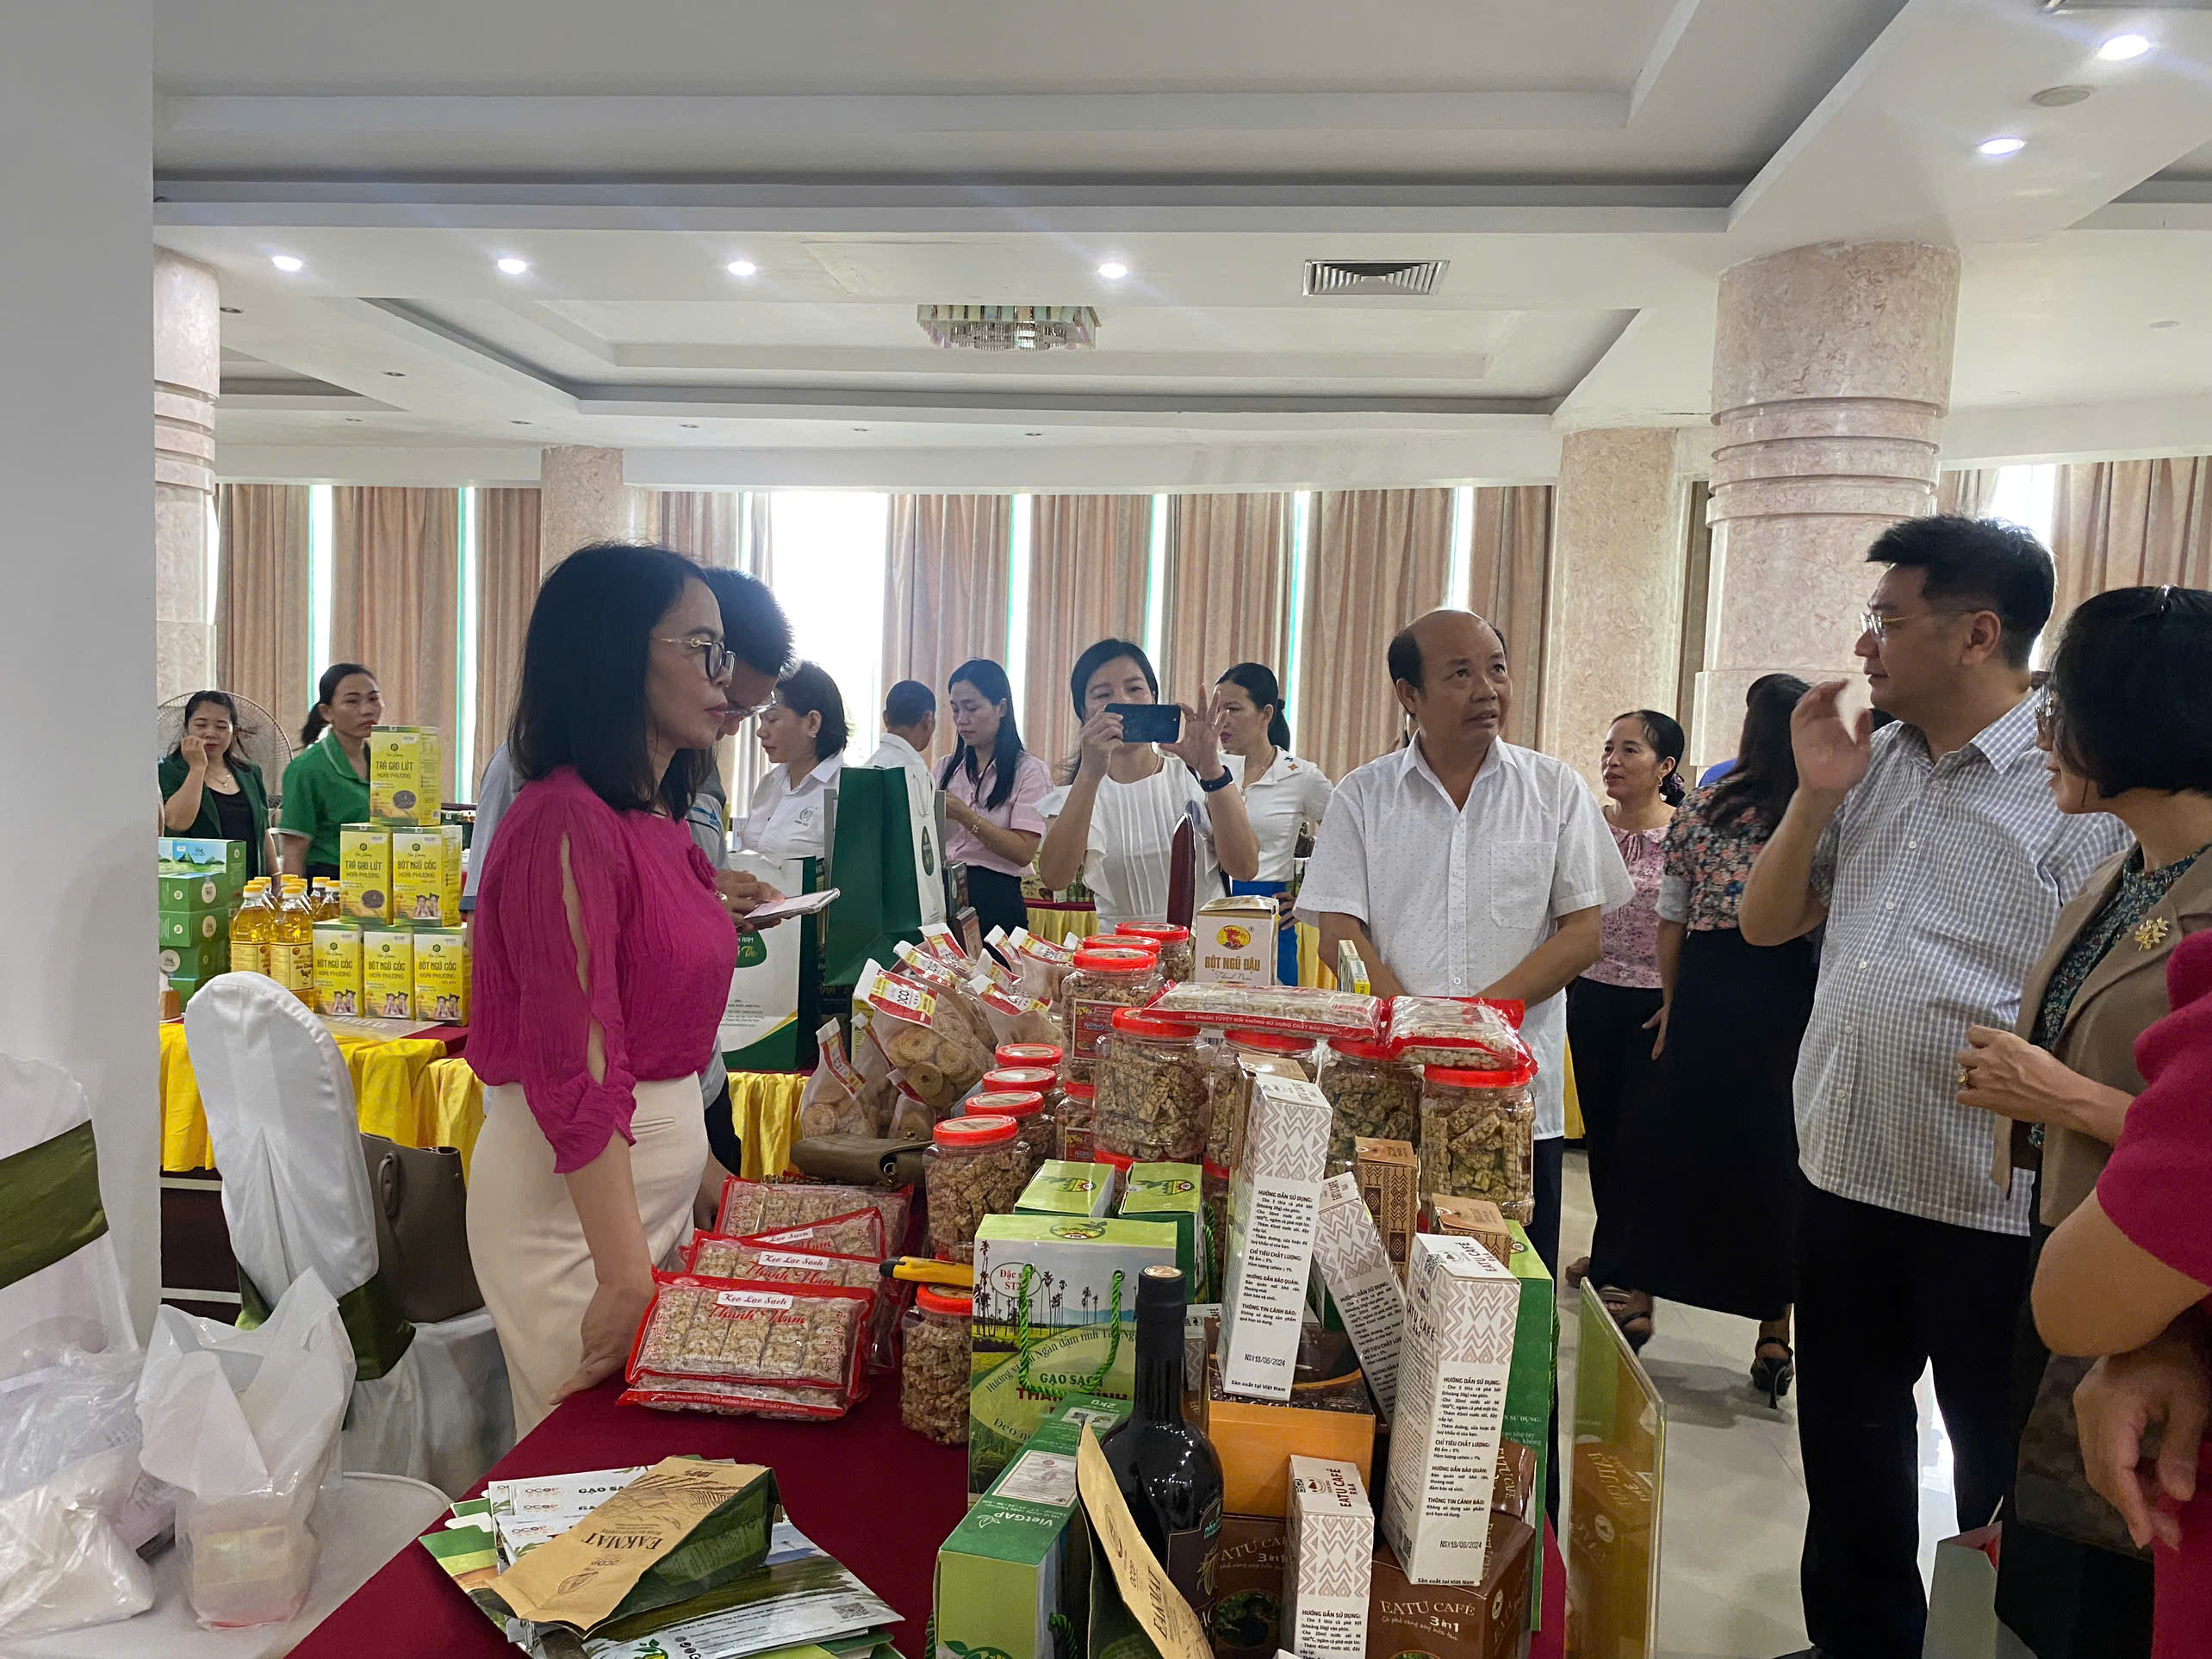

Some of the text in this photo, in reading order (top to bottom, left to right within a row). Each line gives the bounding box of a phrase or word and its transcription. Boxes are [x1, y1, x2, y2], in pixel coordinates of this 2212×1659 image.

[1205, 954, 1260, 973] BỘT NGŨ ĐẬU
[999, 1269, 1016, 1280] Đặc
[761, 1308, 806, 1324] Nam
[985, 1370, 1014, 1393] Hương
[1035, 1342, 1059, 1358] Ngàn
[1040, 1373, 1066, 1386] GẠO
[1090, 1399, 1117, 1409] 2kg
[1326, 1468, 1352, 1507] EATU CAFÉ
[994, 1512, 1053, 1527] VietGAP
[512, 1525, 547, 1534] OCOP
[581, 1532, 664, 1550] EAKMAT
[1221, 1540, 1258, 1562] ATU
[1146, 1565, 1168, 1640] EAKMAT
[1380, 1600, 1476, 1617] EATU CAFÉ
